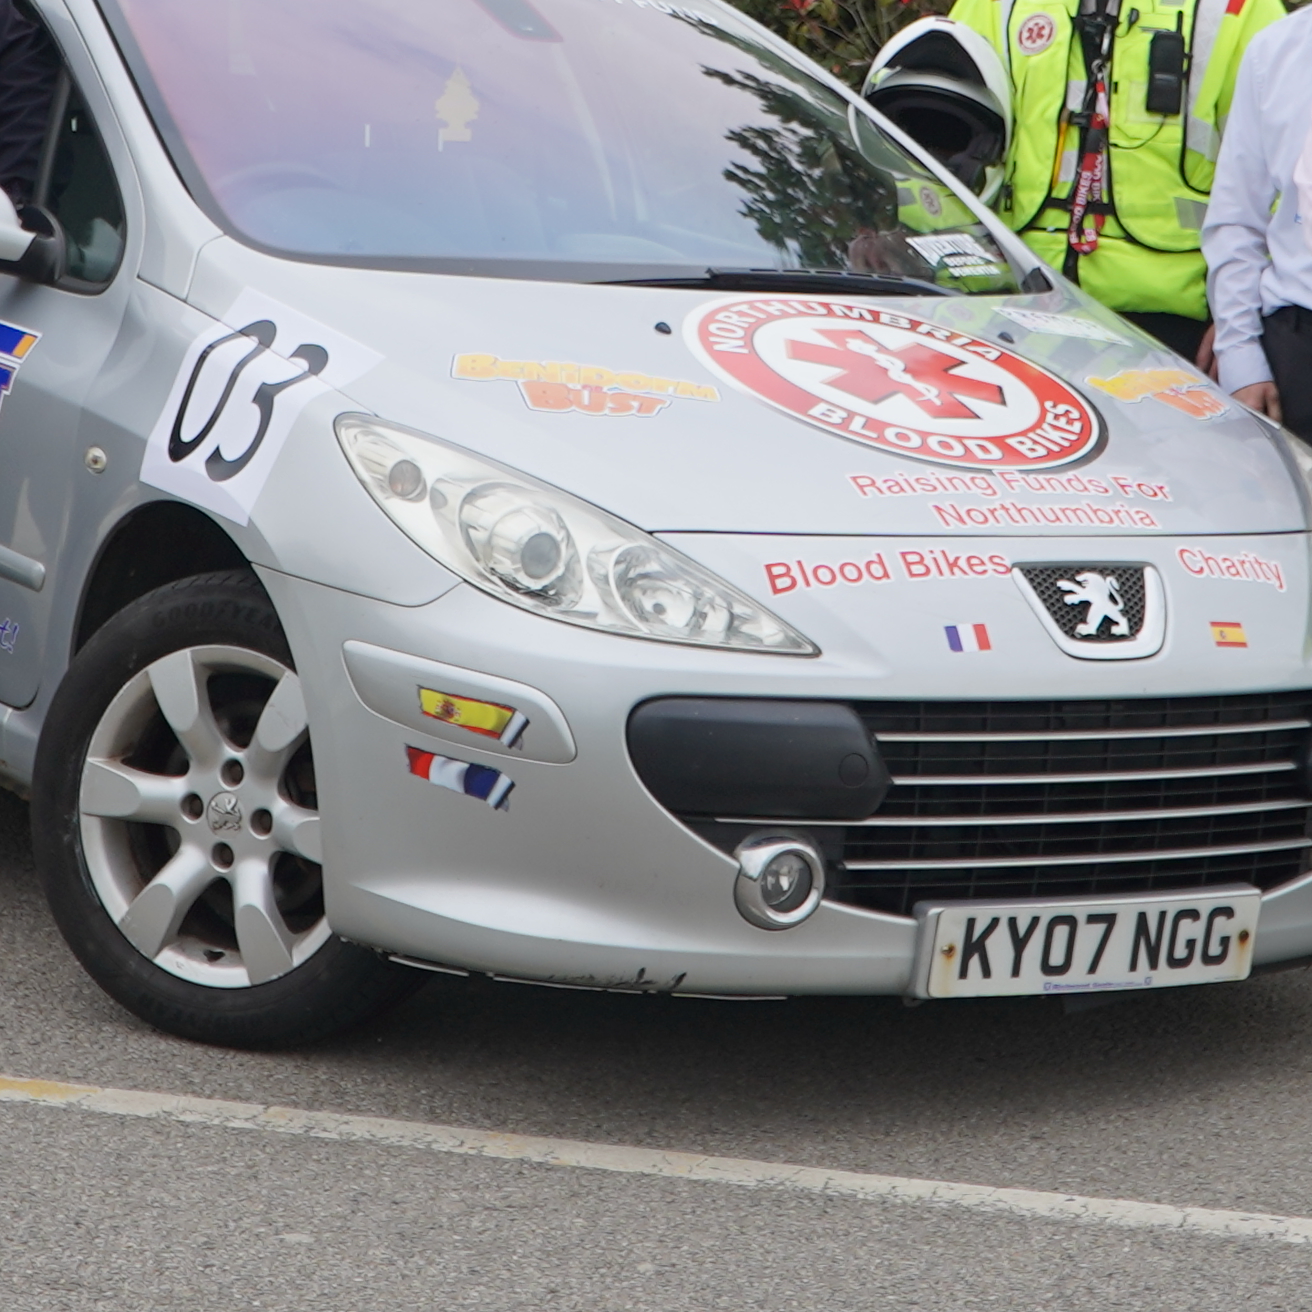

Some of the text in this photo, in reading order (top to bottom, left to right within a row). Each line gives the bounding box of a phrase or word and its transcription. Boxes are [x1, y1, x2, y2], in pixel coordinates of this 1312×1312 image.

[710, 300, 1004, 362] NORTHUMBRIA
[168, 320, 329, 482] 03
[806, 402, 1004, 461] BLOOD
[1005, 399, 1084, 460] BIKES
[848, 471, 1170, 500] Raising Funds For
[930, 501, 1157, 529] Northumbria
[763, 546, 1286, 595] Blood Bikes Charity
[958, 905, 1235, 980] KY07 NGG
